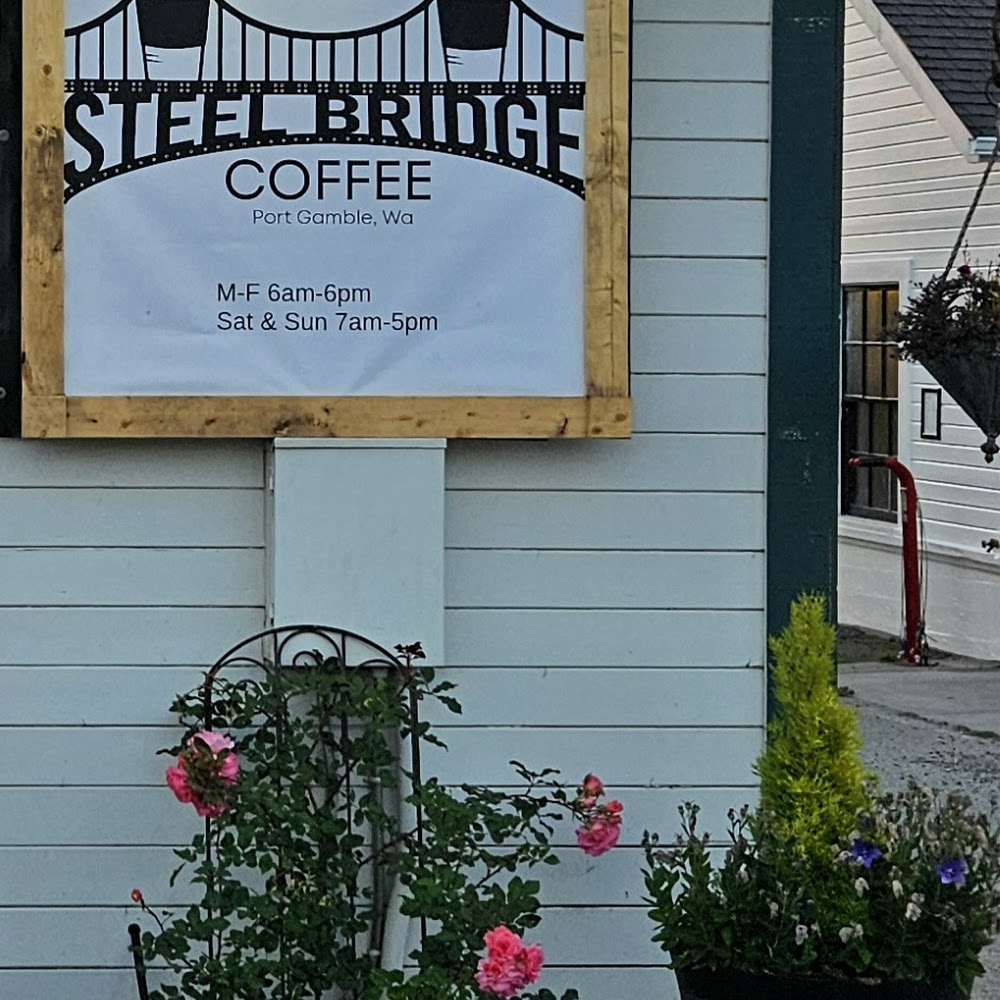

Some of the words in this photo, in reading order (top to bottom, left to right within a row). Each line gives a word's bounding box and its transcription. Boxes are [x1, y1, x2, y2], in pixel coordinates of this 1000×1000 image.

[64, 93, 287, 188] STEEL
[315, 94, 585, 182] BRIDGE
[225, 158, 432, 201] COFFEE
[252, 209, 292, 225] Port
[296, 209, 377, 227] Gamble,
[382, 209, 414, 225] Wa
[217, 283, 260, 302] M-F
[267, 282, 371, 308] 6am-6pm
[216, 311, 253, 331] Sat
[260, 311, 278, 331] &
[284, 311, 328, 331] Sun
[334, 311, 438, 337] 7am-5pm
